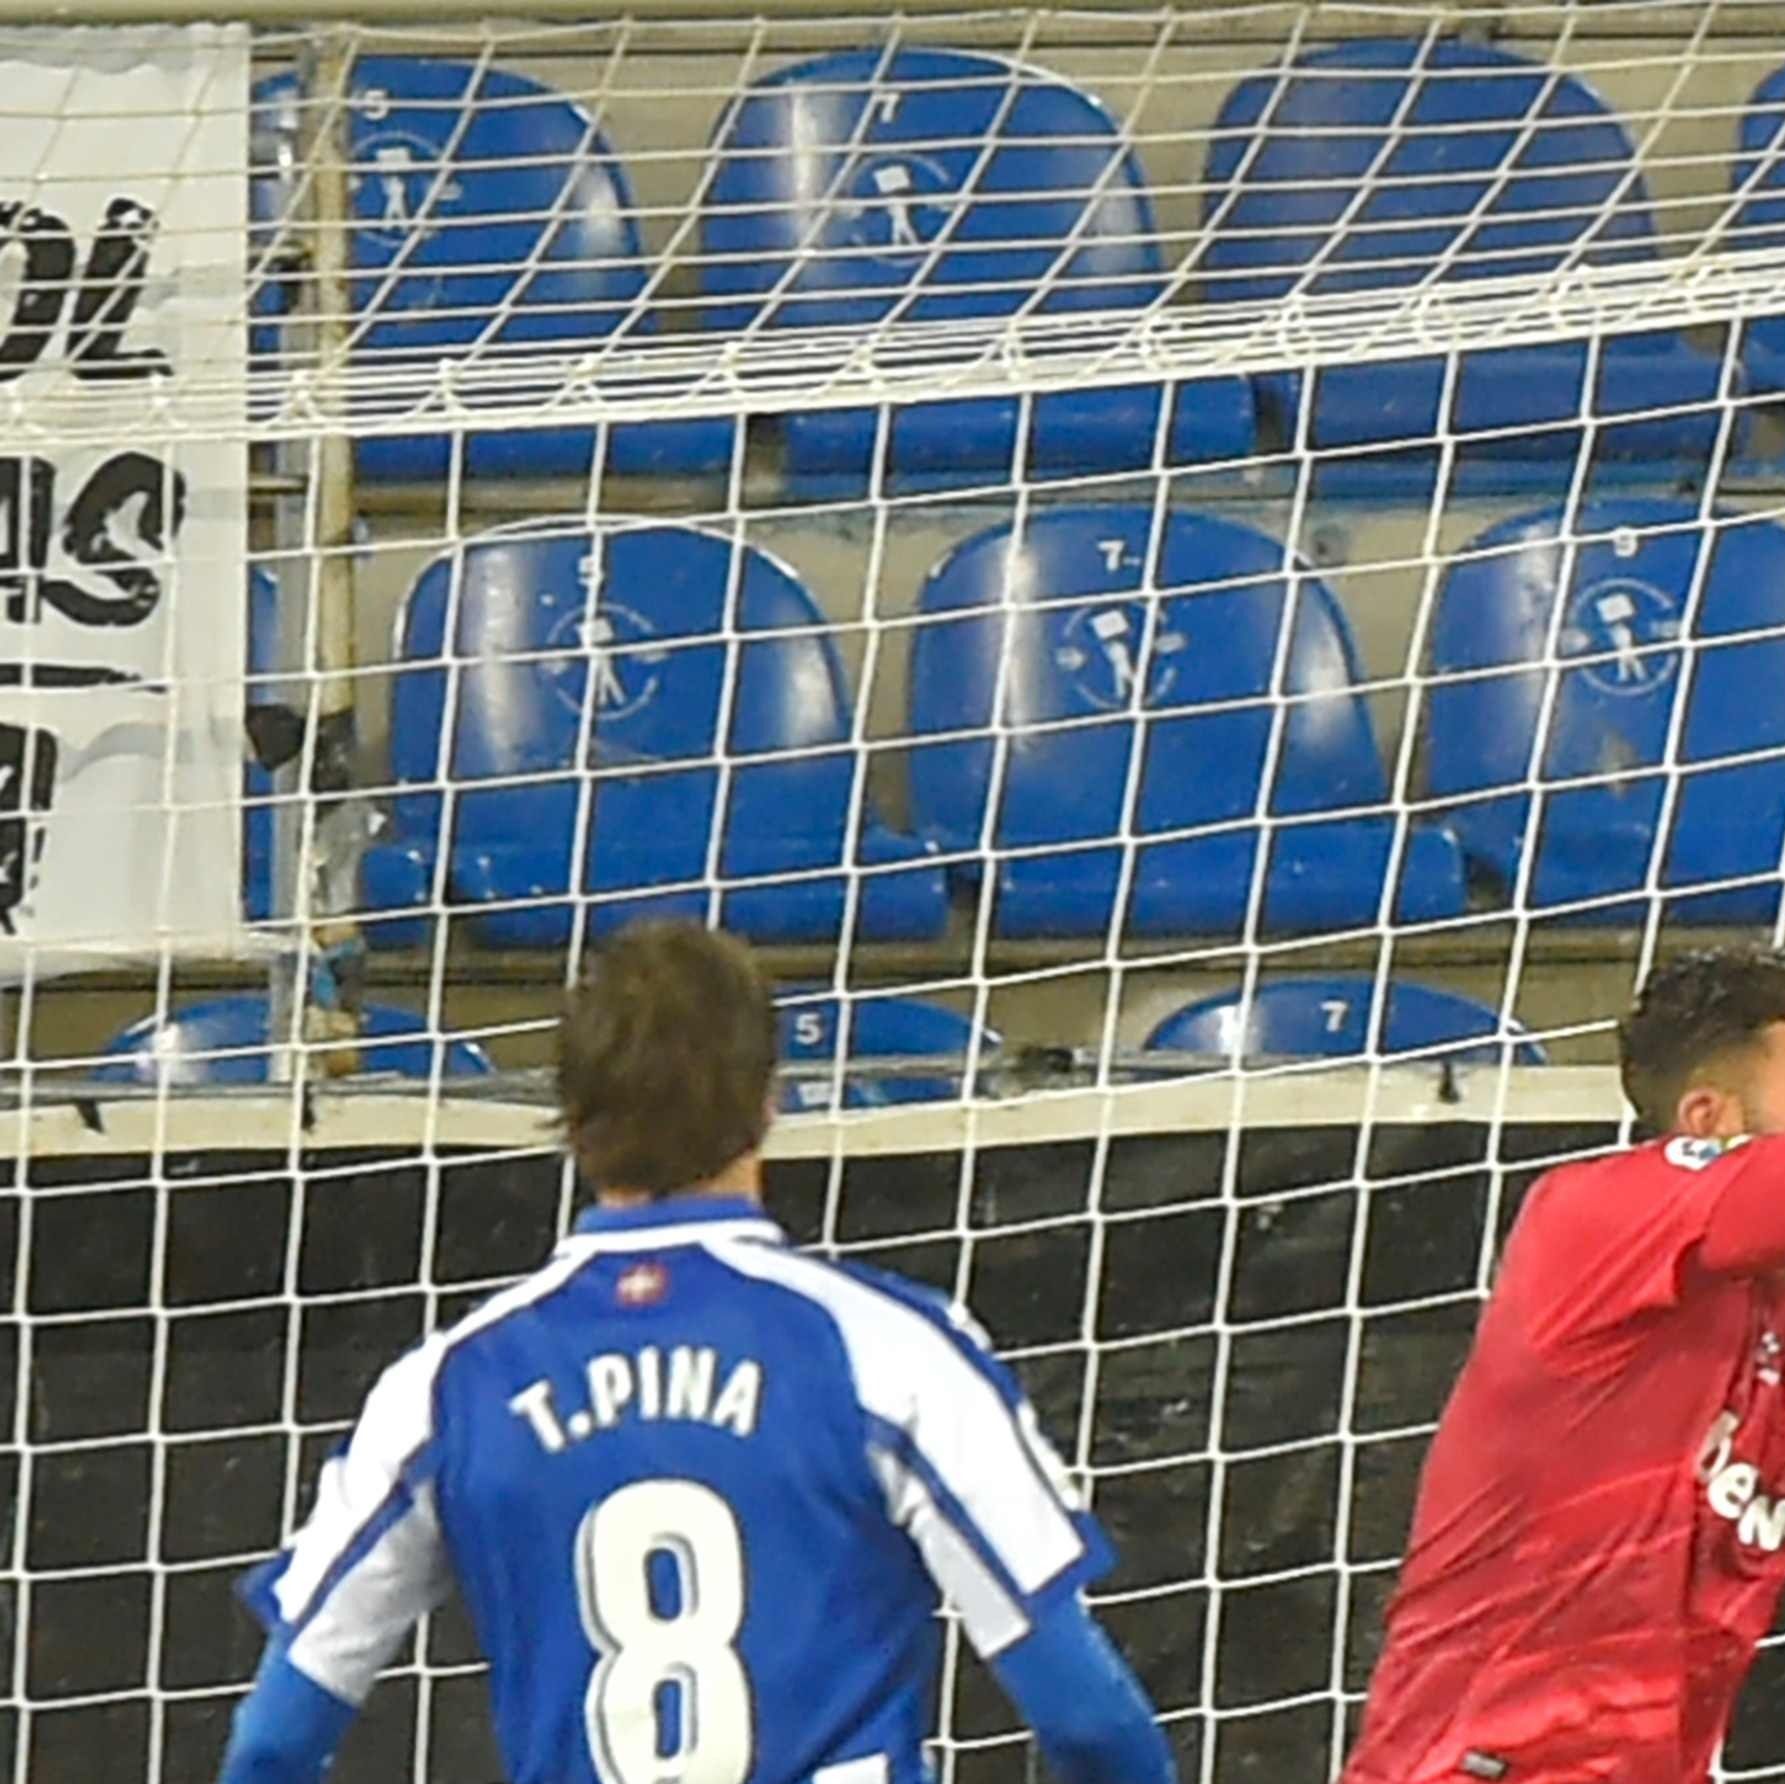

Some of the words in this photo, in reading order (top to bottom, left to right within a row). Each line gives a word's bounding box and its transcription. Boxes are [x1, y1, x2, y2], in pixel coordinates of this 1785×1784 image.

[1098, 539, 1123, 570] 7
[795, 1012, 822, 1044] 5
[1320, 1000, 1348, 1031] 7
[509, 1345, 762, 1452] T.PINA
